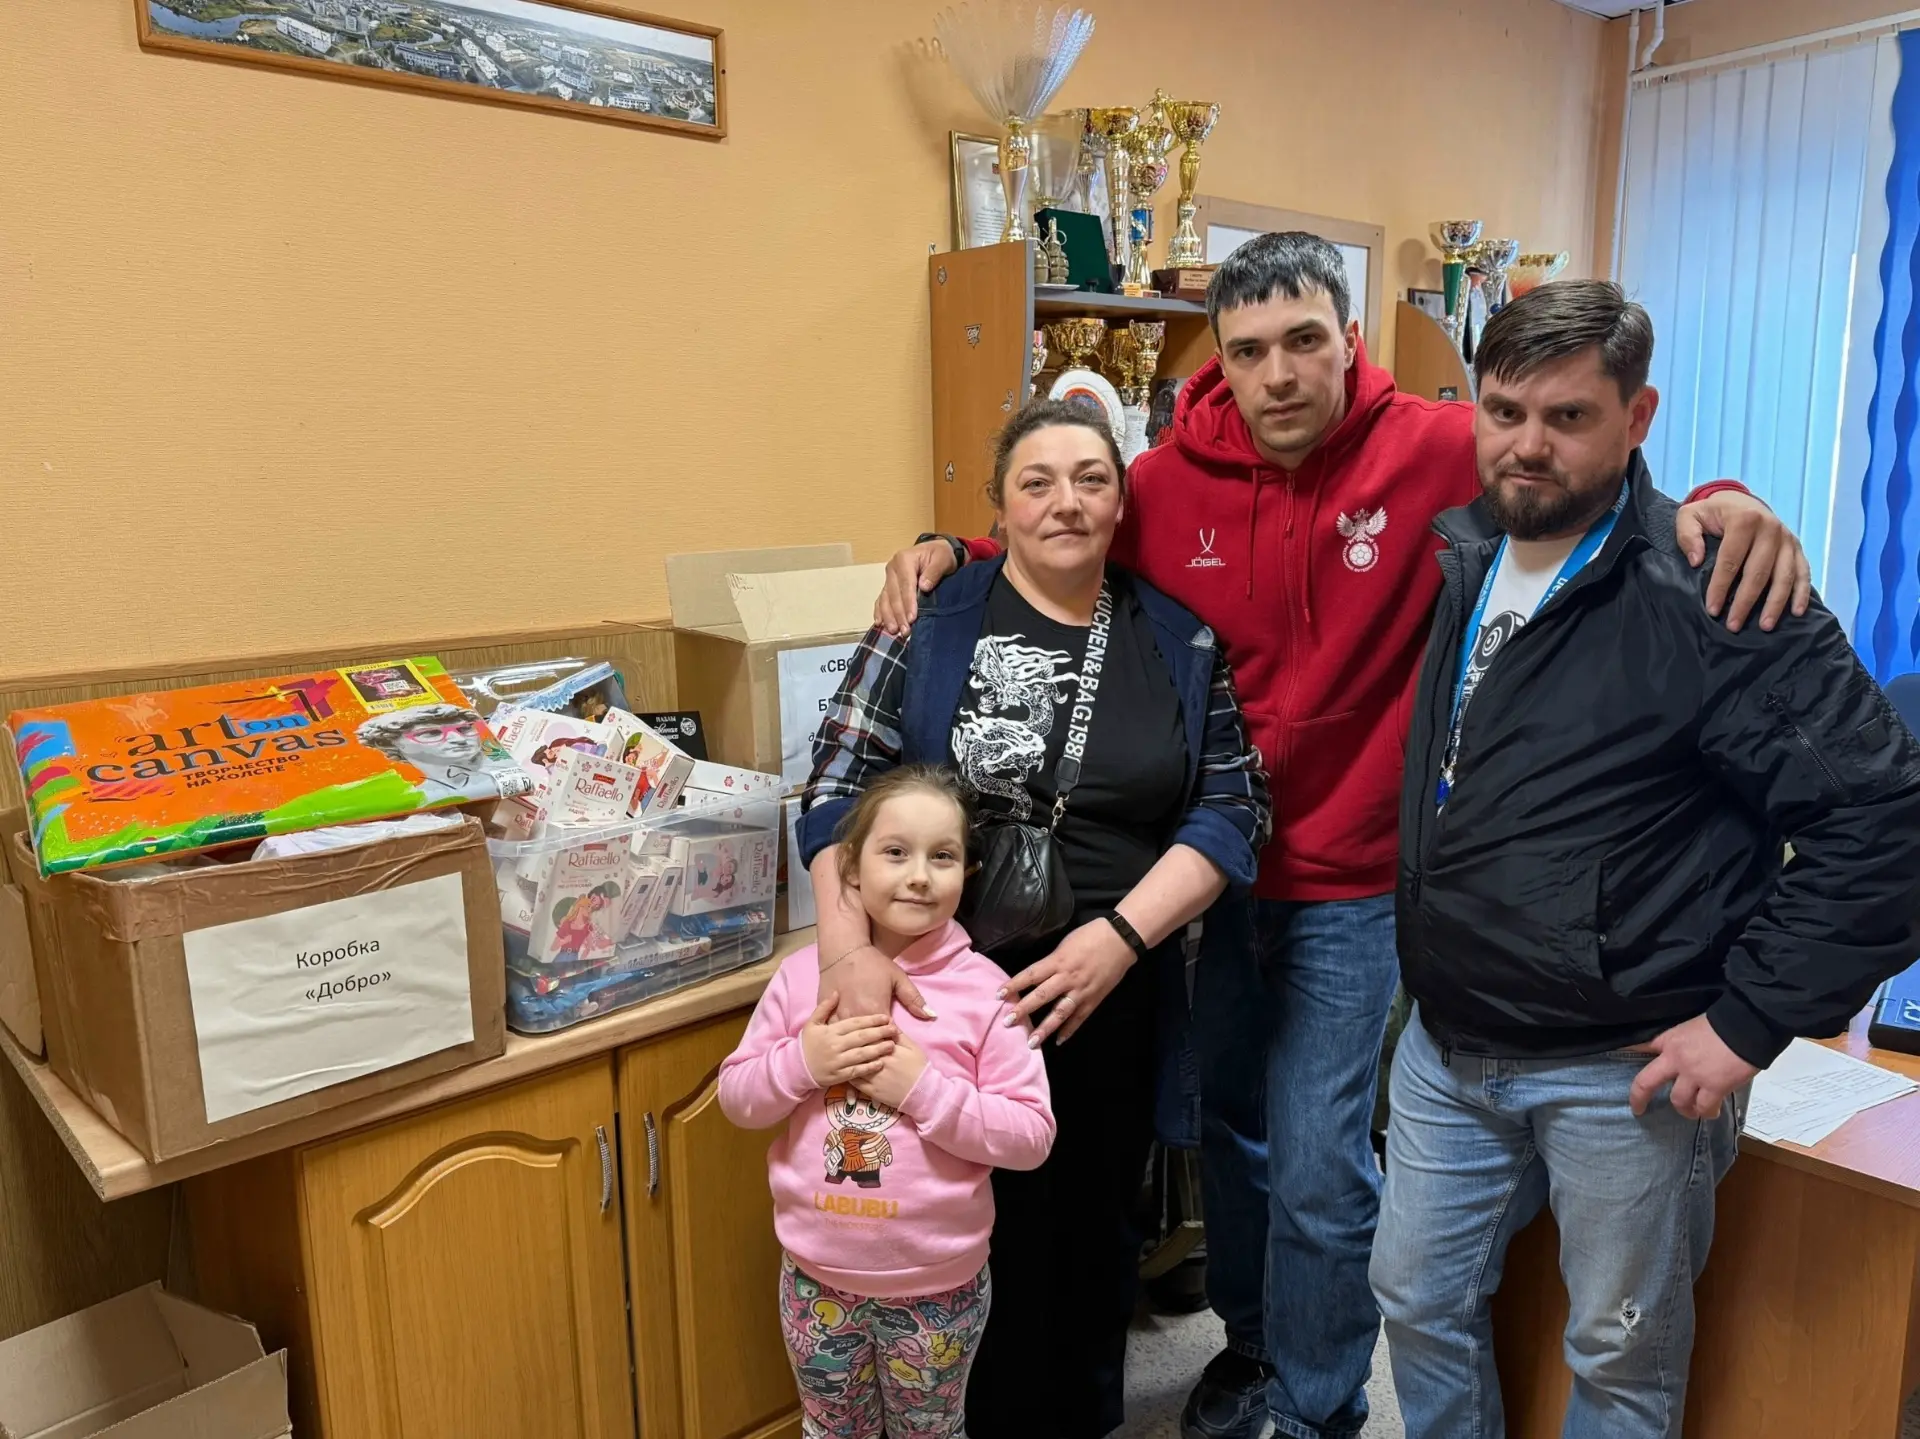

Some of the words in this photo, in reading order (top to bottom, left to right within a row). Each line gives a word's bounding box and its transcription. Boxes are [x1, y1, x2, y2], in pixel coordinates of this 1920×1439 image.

[1185, 557, 1226, 568] JÖGEL
[1063, 588, 1113, 759] KUCHEN&BAG.198
[127, 713, 252, 757] art
[86, 728, 348, 783] canvas
[183, 754, 300, 781] ТВОРЧЕСТВО
[186, 778, 212, 789] НА
[216, 764, 285, 781] ХОЛСТЕ
[575, 778, 624, 801] Raffaello
[657, 776, 680, 809] Raffaello
[568, 852, 620, 867] Raffaello
[751, 842, 764, 894] Raffaello
[296, 939, 380, 969] Коробка
[305, 971, 392, 1002] «Добро»
[814, 1191, 898, 1219] LABUBU
